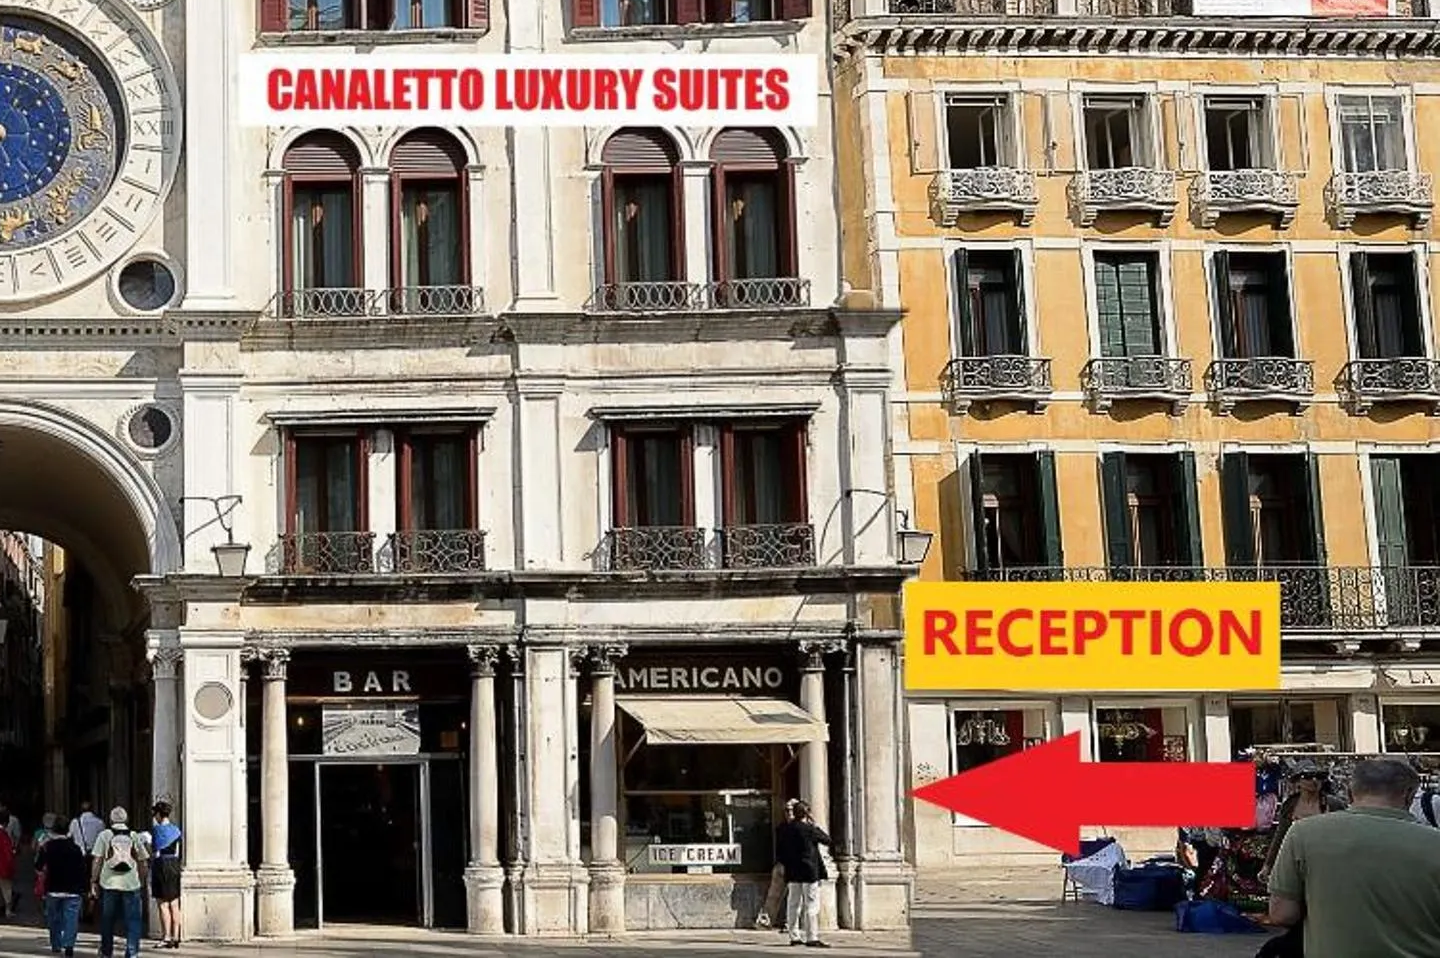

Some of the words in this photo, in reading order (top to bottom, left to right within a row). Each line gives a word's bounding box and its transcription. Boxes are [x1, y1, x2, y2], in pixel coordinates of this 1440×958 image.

[333, 670, 412, 692] BAR
[614, 667, 783, 688] AMERICANO
[652, 848, 676, 861] ICE
[686, 848, 736, 861] CREAM
